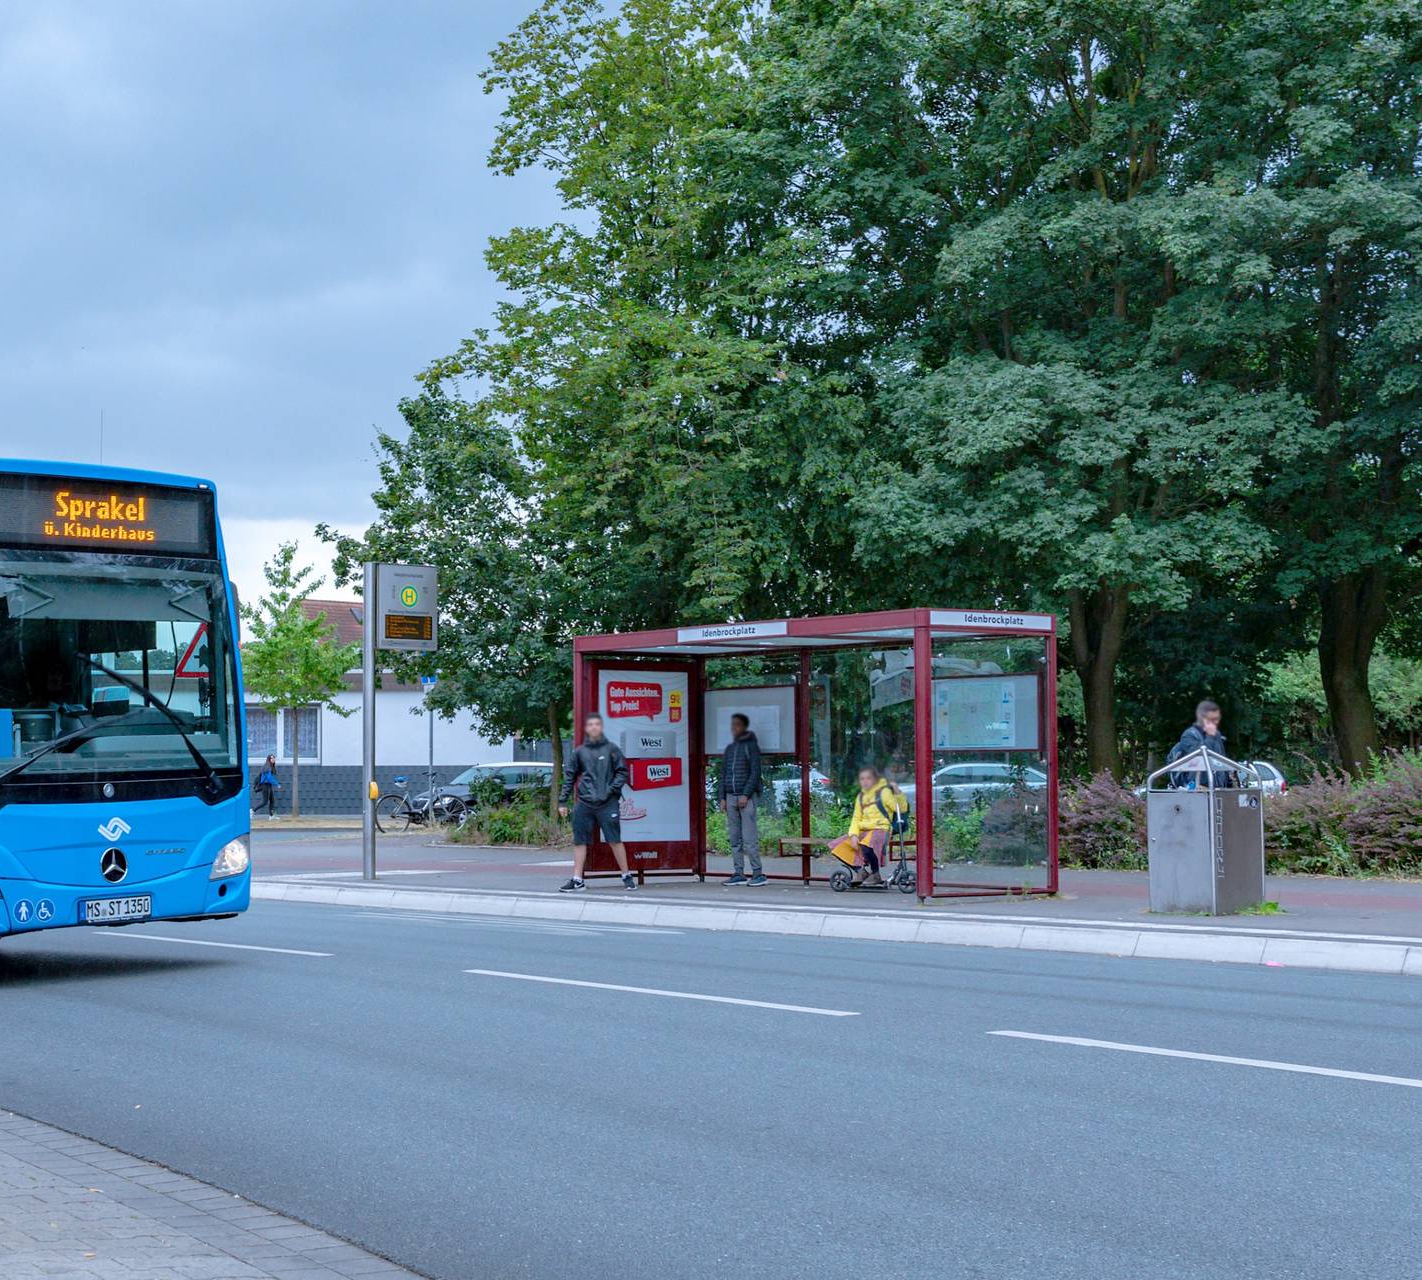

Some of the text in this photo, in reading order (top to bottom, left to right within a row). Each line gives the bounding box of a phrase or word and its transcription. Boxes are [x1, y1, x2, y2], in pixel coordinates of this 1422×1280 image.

[55, 491, 147, 521] Sprakel
[64, 522, 155, 541] Kinderhaus
[964, 614, 1024, 626] Idenbrockplatz
[702, 626, 756, 638] Idenbrockplatz
[609, 686, 625, 698] Gute
[609, 700, 640, 713] Top Preis!
[641, 737, 662, 748] West
[649, 767, 670, 777] West
[86, 897, 150, 918] MS ST 1350
